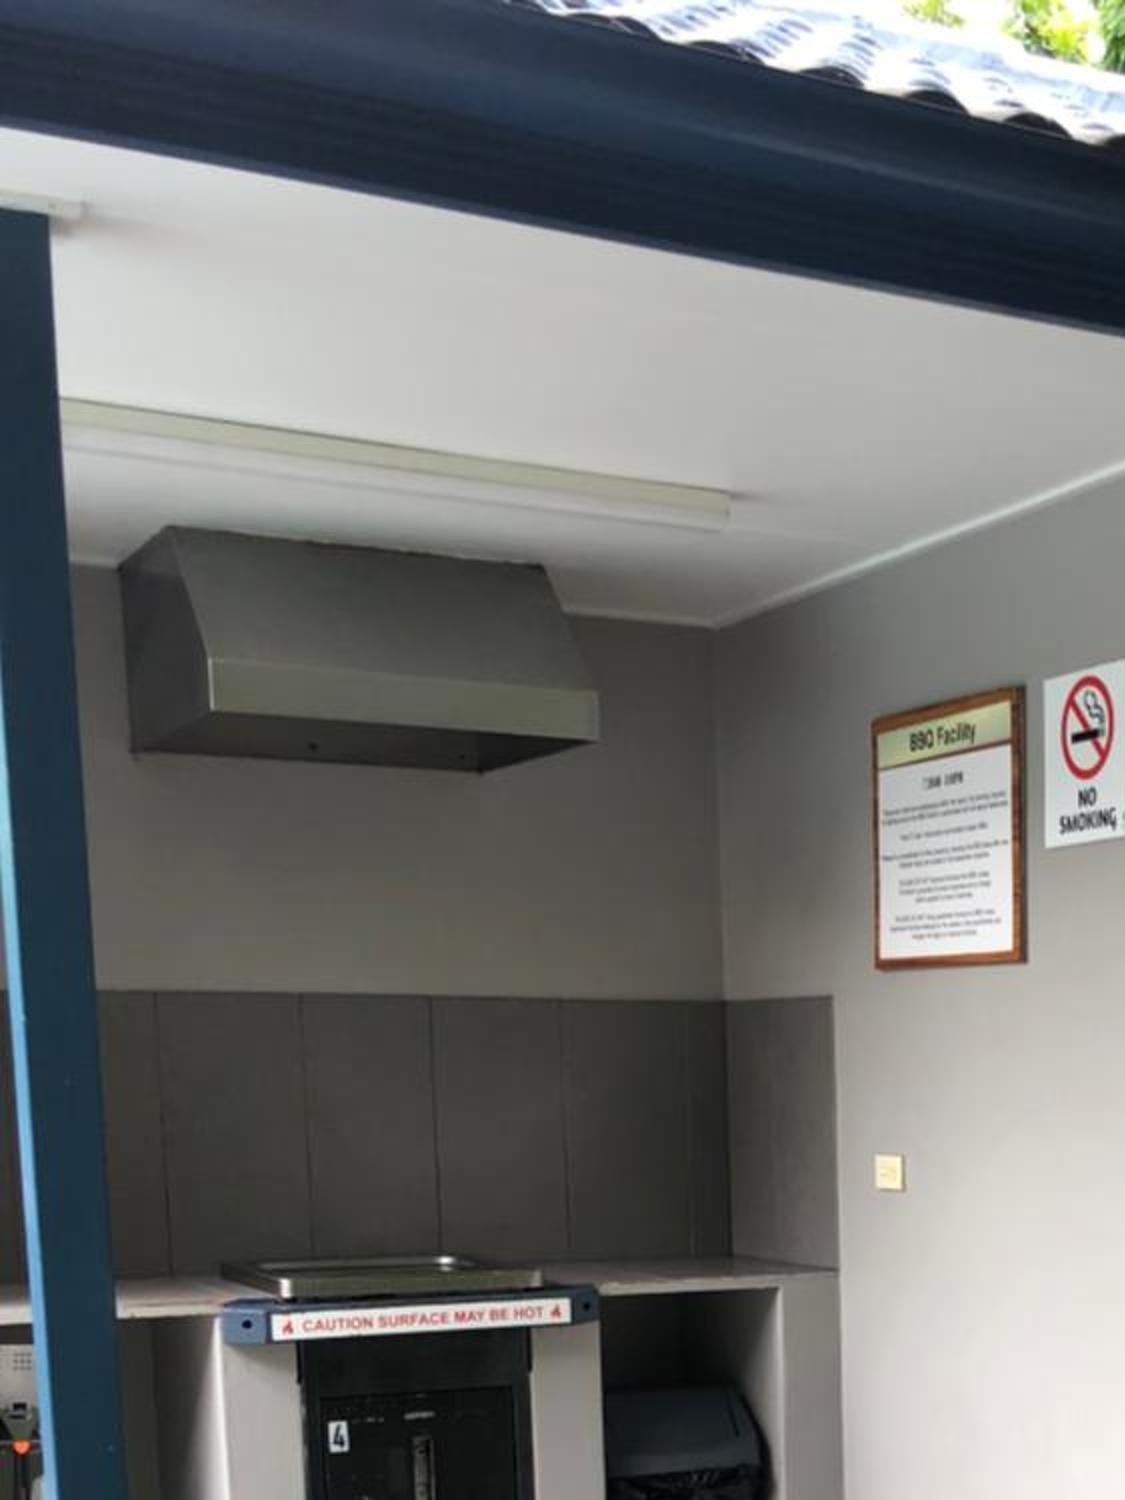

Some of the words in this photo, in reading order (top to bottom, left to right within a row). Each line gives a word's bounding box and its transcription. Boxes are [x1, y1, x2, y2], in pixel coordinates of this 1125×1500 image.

[909, 729, 934, 752] BBQ
[937, 722, 976, 745] Facility
[1078, 786, 1097, 808] NO
[1059, 806, 1117, 835] SMOKING
[302, 1316, 374, 1332] CAUTION
[377, 1312, 449, 1328] SURFACE
[453, 1310, 485, 1323] MAY
[488, 1308, 508, 1321] BE
[513, 1305, 544, 1319] HOT
[333, 1424, 346, 1448] 4
